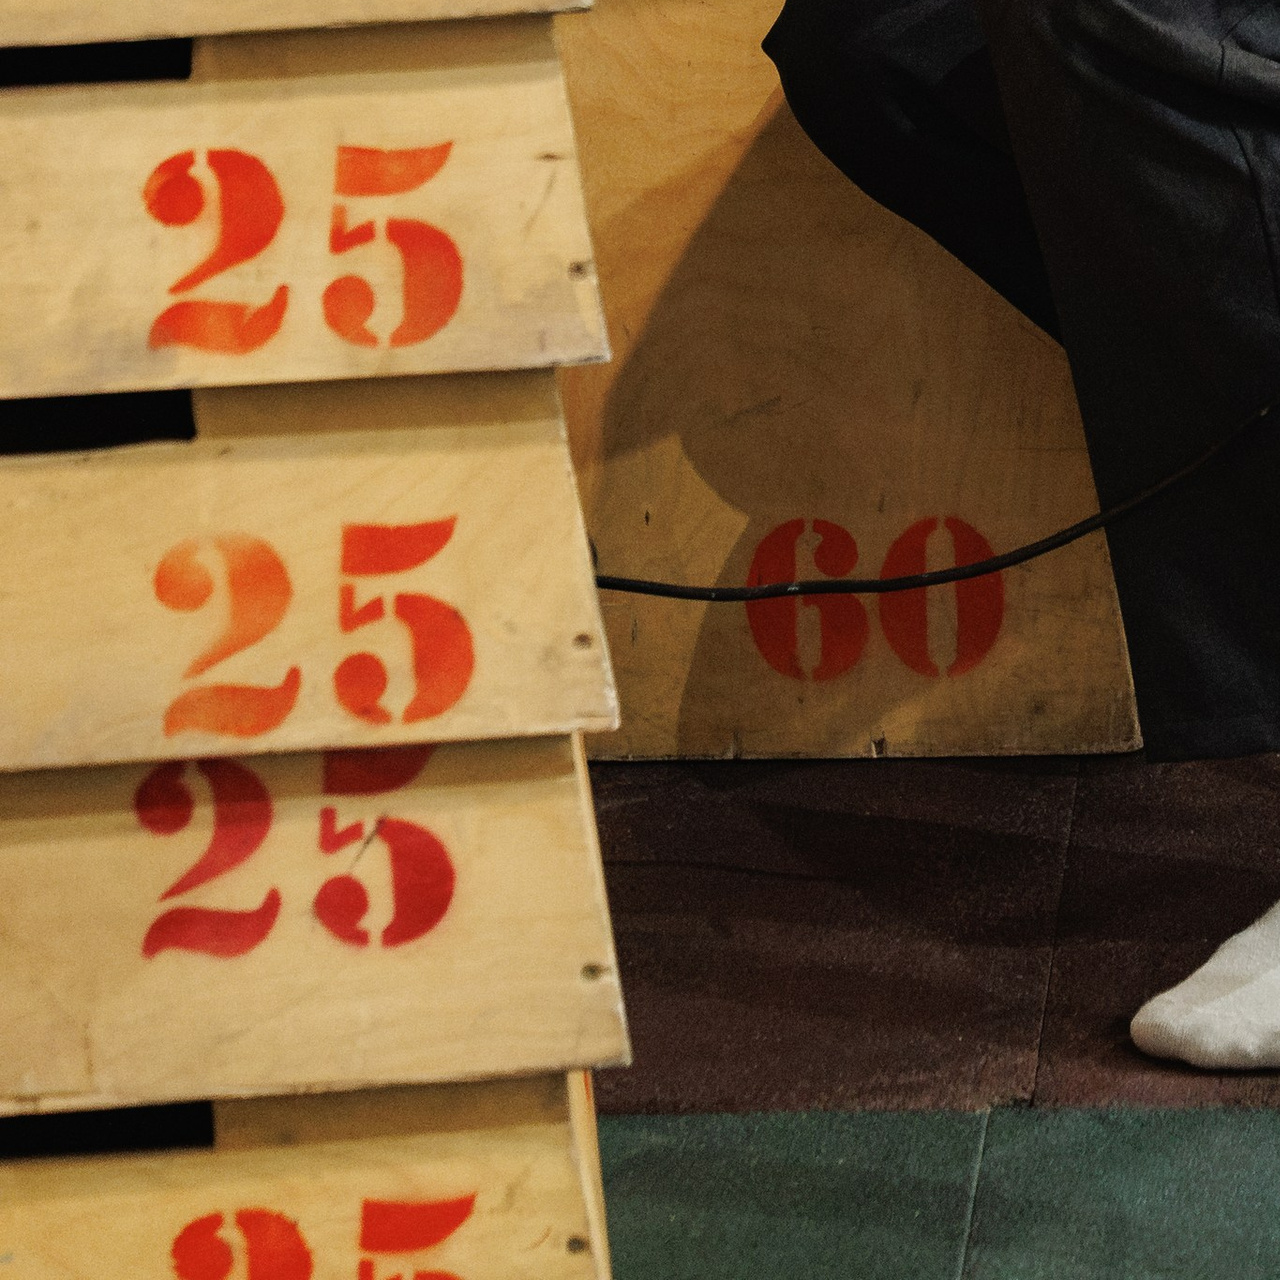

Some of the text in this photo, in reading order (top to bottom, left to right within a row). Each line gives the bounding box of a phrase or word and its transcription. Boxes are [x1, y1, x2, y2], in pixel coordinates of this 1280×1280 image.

[142, 141, 464, 356] 25
[152, 514, 475, 739] 25
[745, 514, 1005, 682] 60
[133, 744, 457, 959] 25
